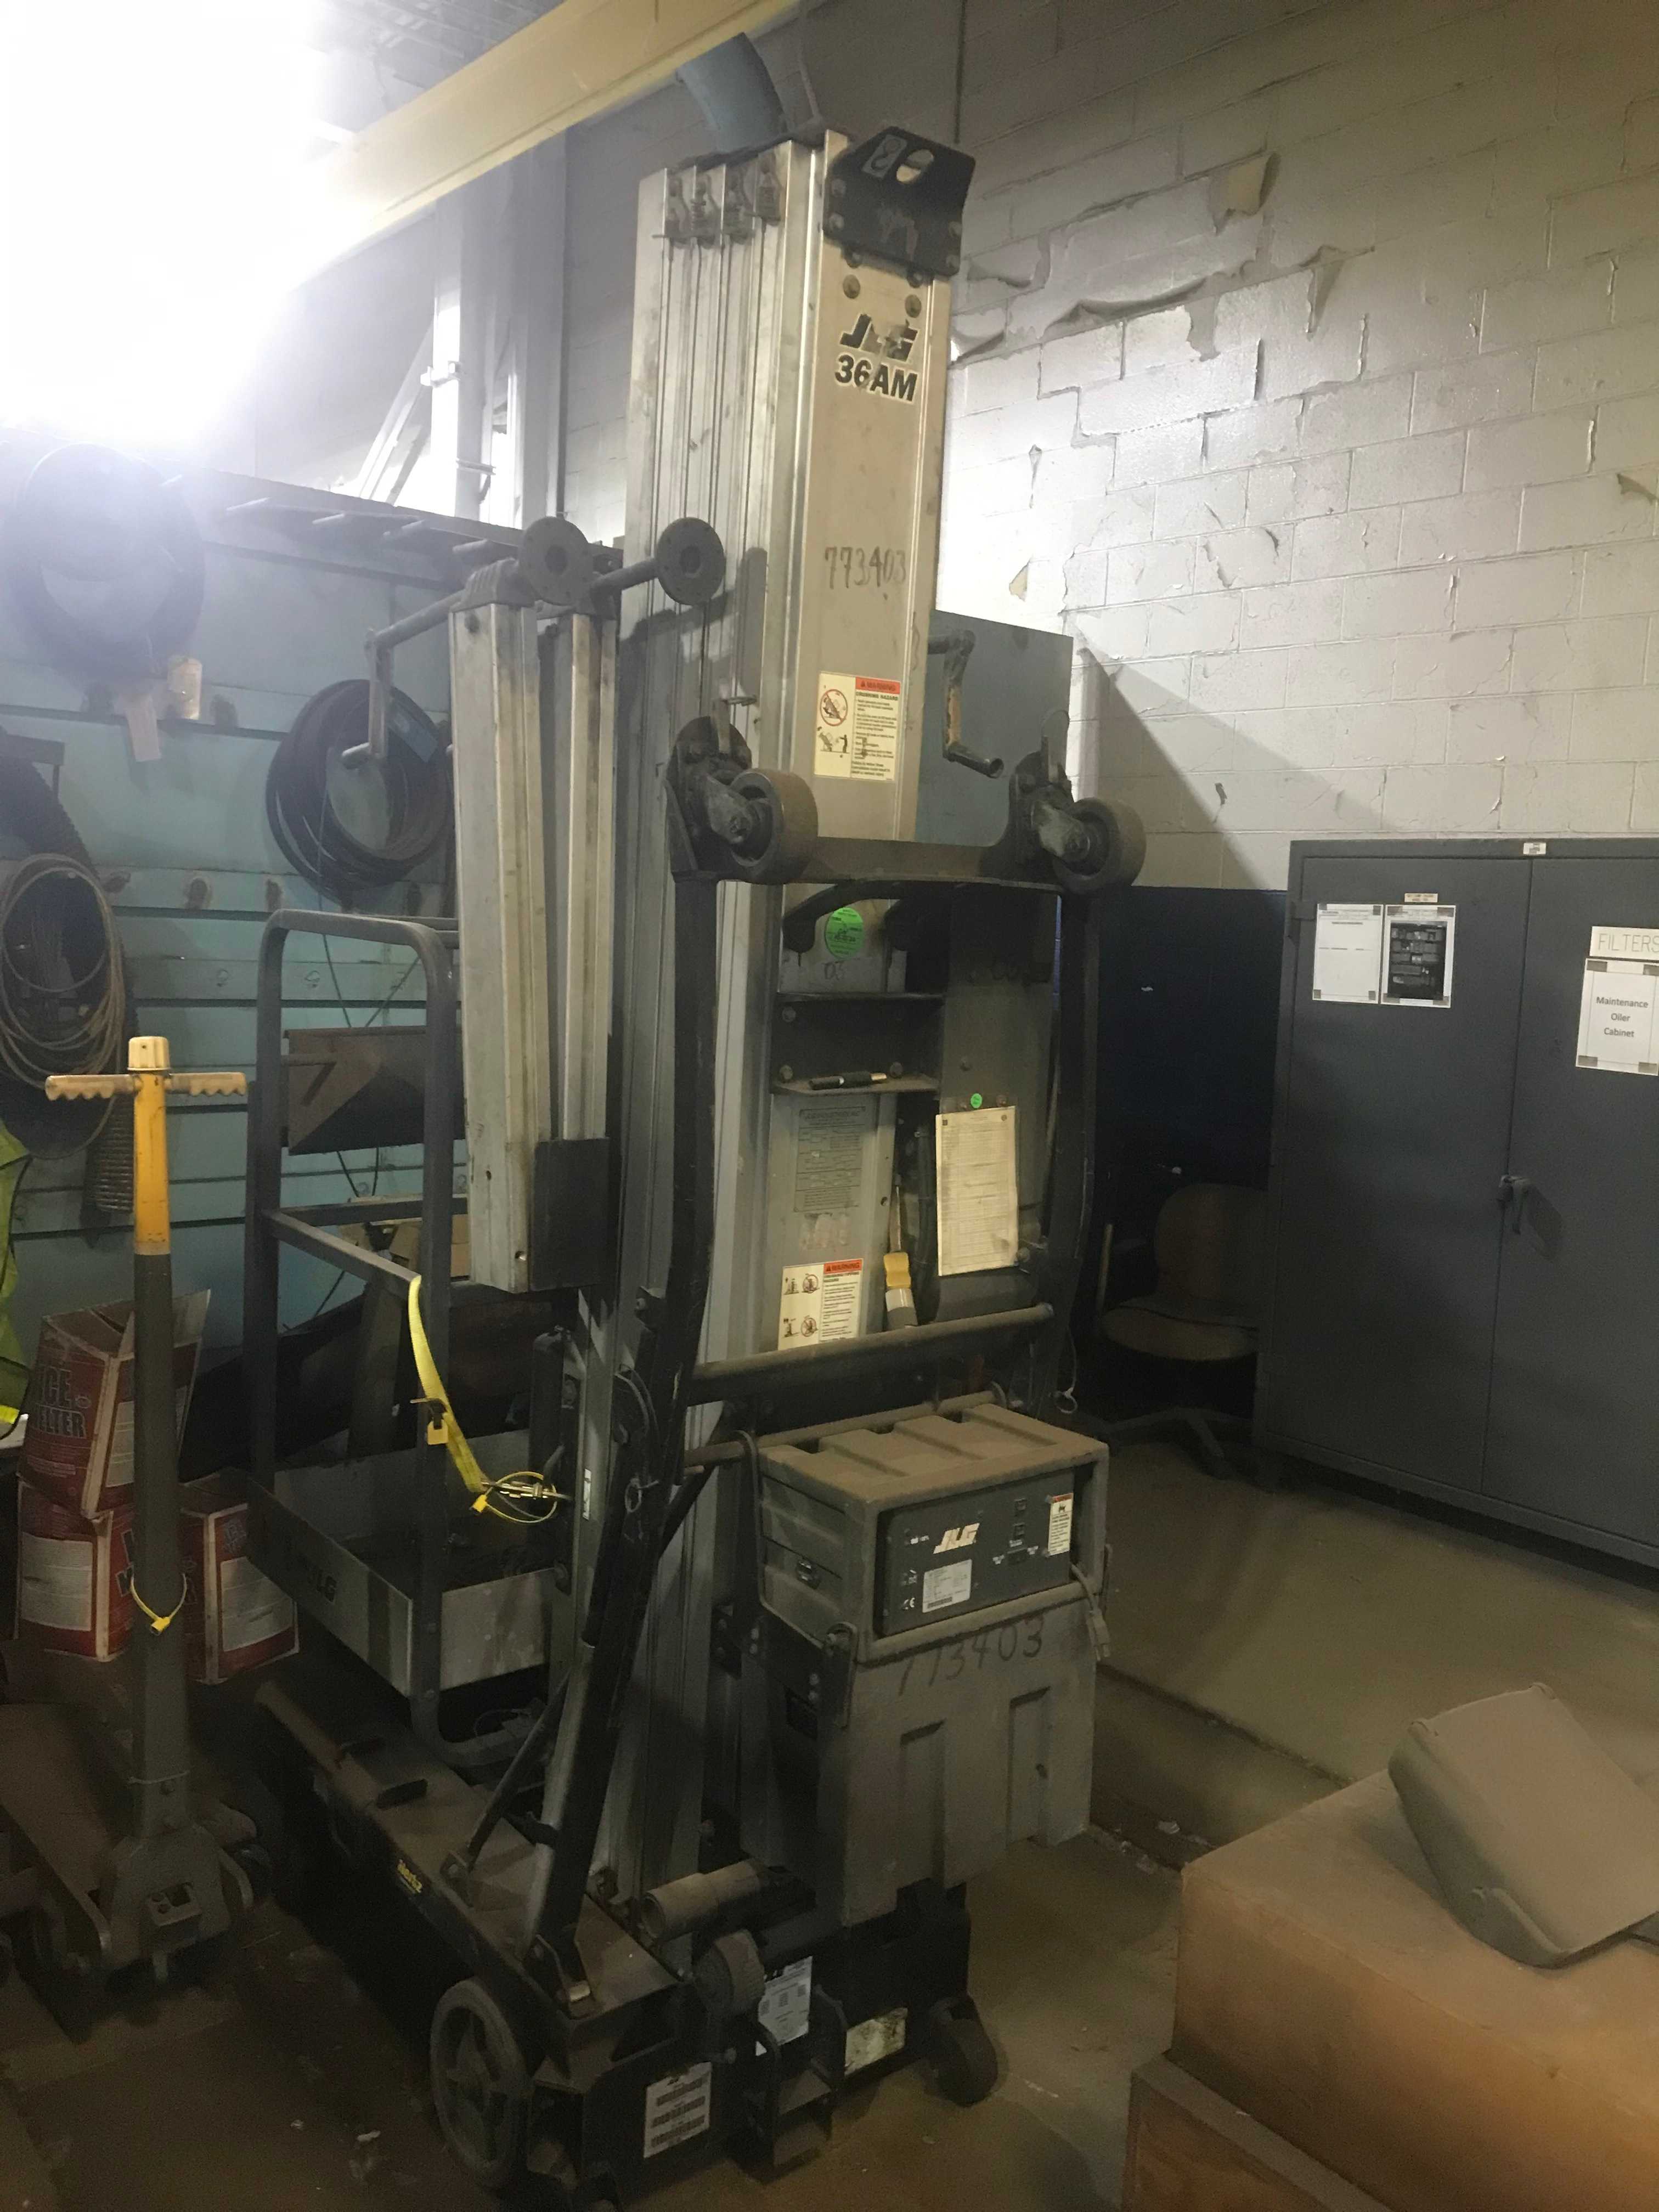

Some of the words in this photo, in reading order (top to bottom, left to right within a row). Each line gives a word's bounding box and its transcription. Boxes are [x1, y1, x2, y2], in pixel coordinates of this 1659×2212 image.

[834, 354, 918, 402] 36AM
[825, 545, 906, 590] 773403
[1598, 933, 1659, 953] FILTERS
[1596, 996, 1649, 1008] Maintenance
[1611, 1012, 1630, 1022] Oiler
[1604, 1027, 1635, 1037] Cabinet
[933, 1522, 980, 1554] JLG
